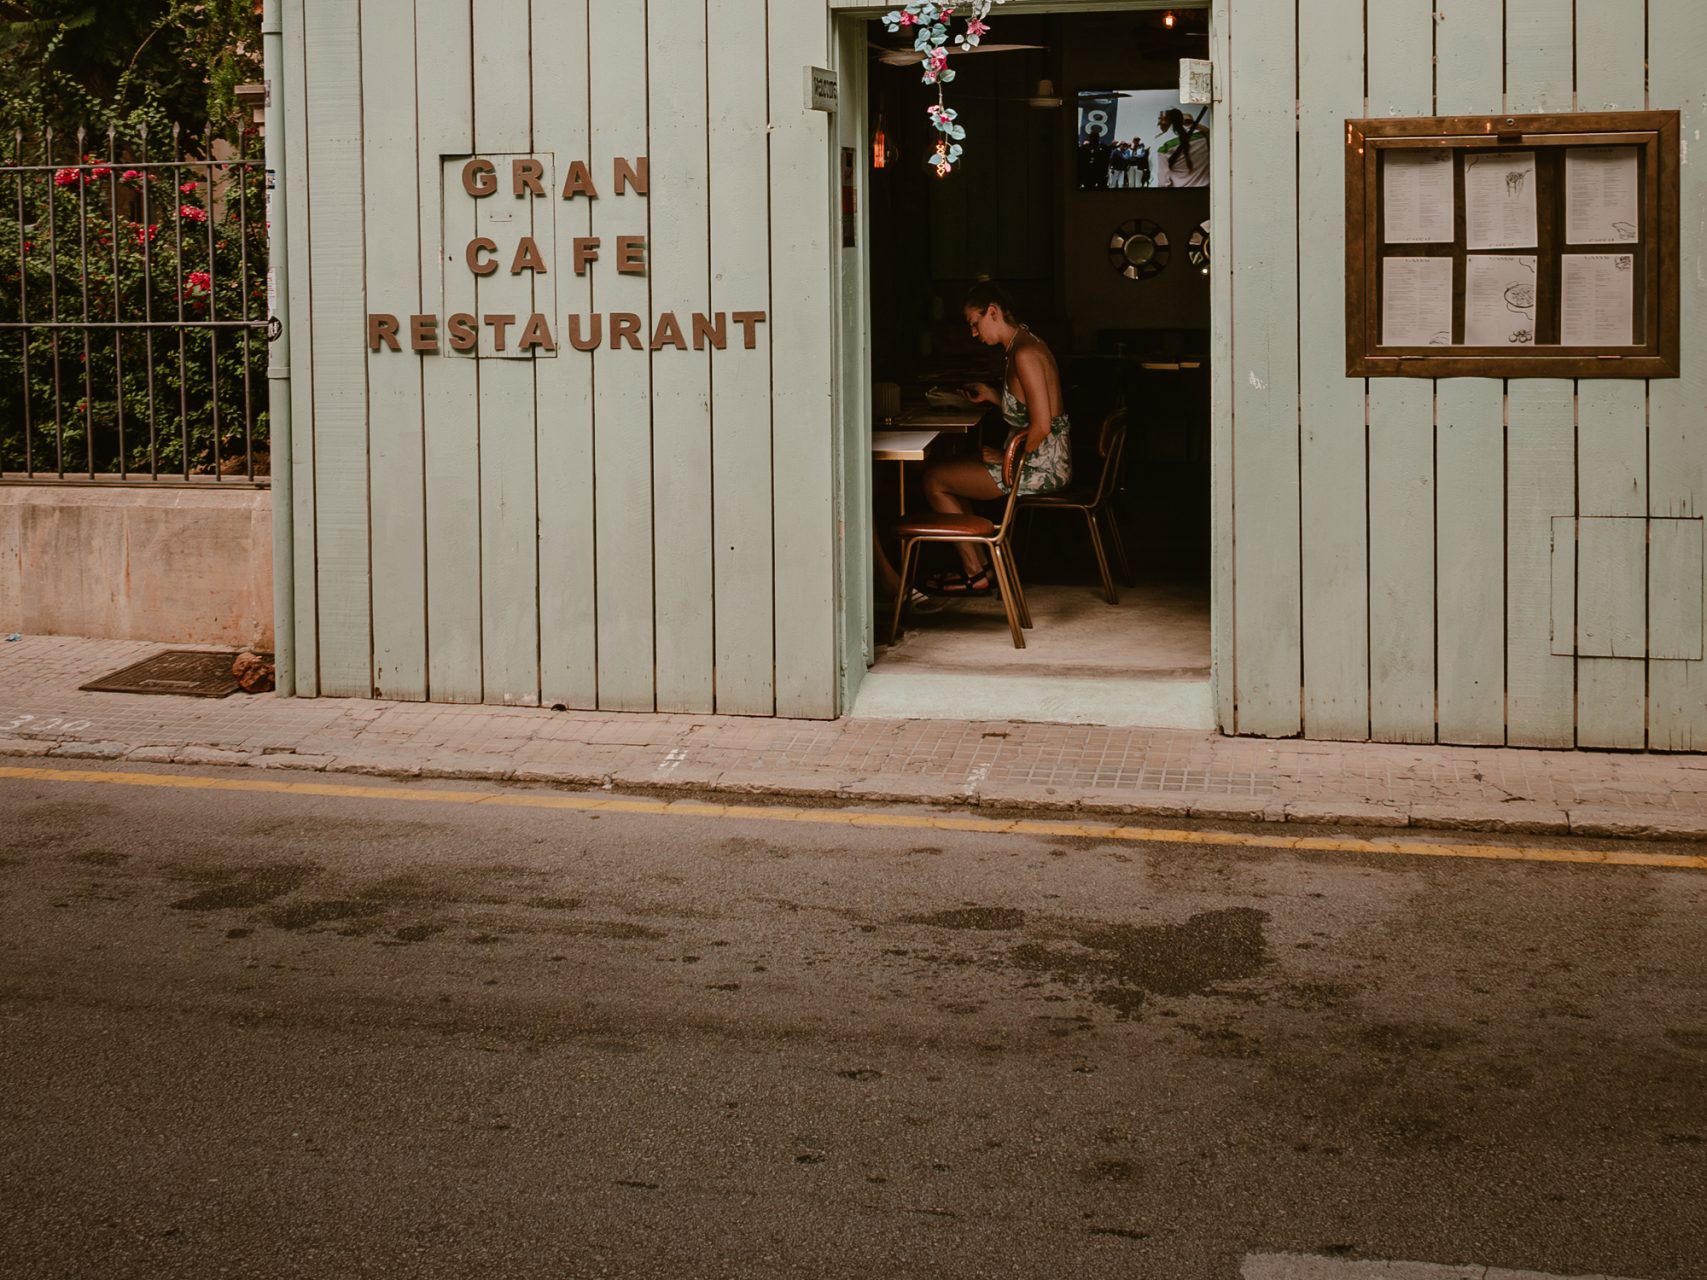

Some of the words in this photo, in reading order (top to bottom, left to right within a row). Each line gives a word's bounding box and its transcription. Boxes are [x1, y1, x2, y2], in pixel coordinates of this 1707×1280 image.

[462, 157, 648, 199] GRAN
[465, 235, 646, 274] CAFE
[368, 311, 766, 352] RESTAURANT
